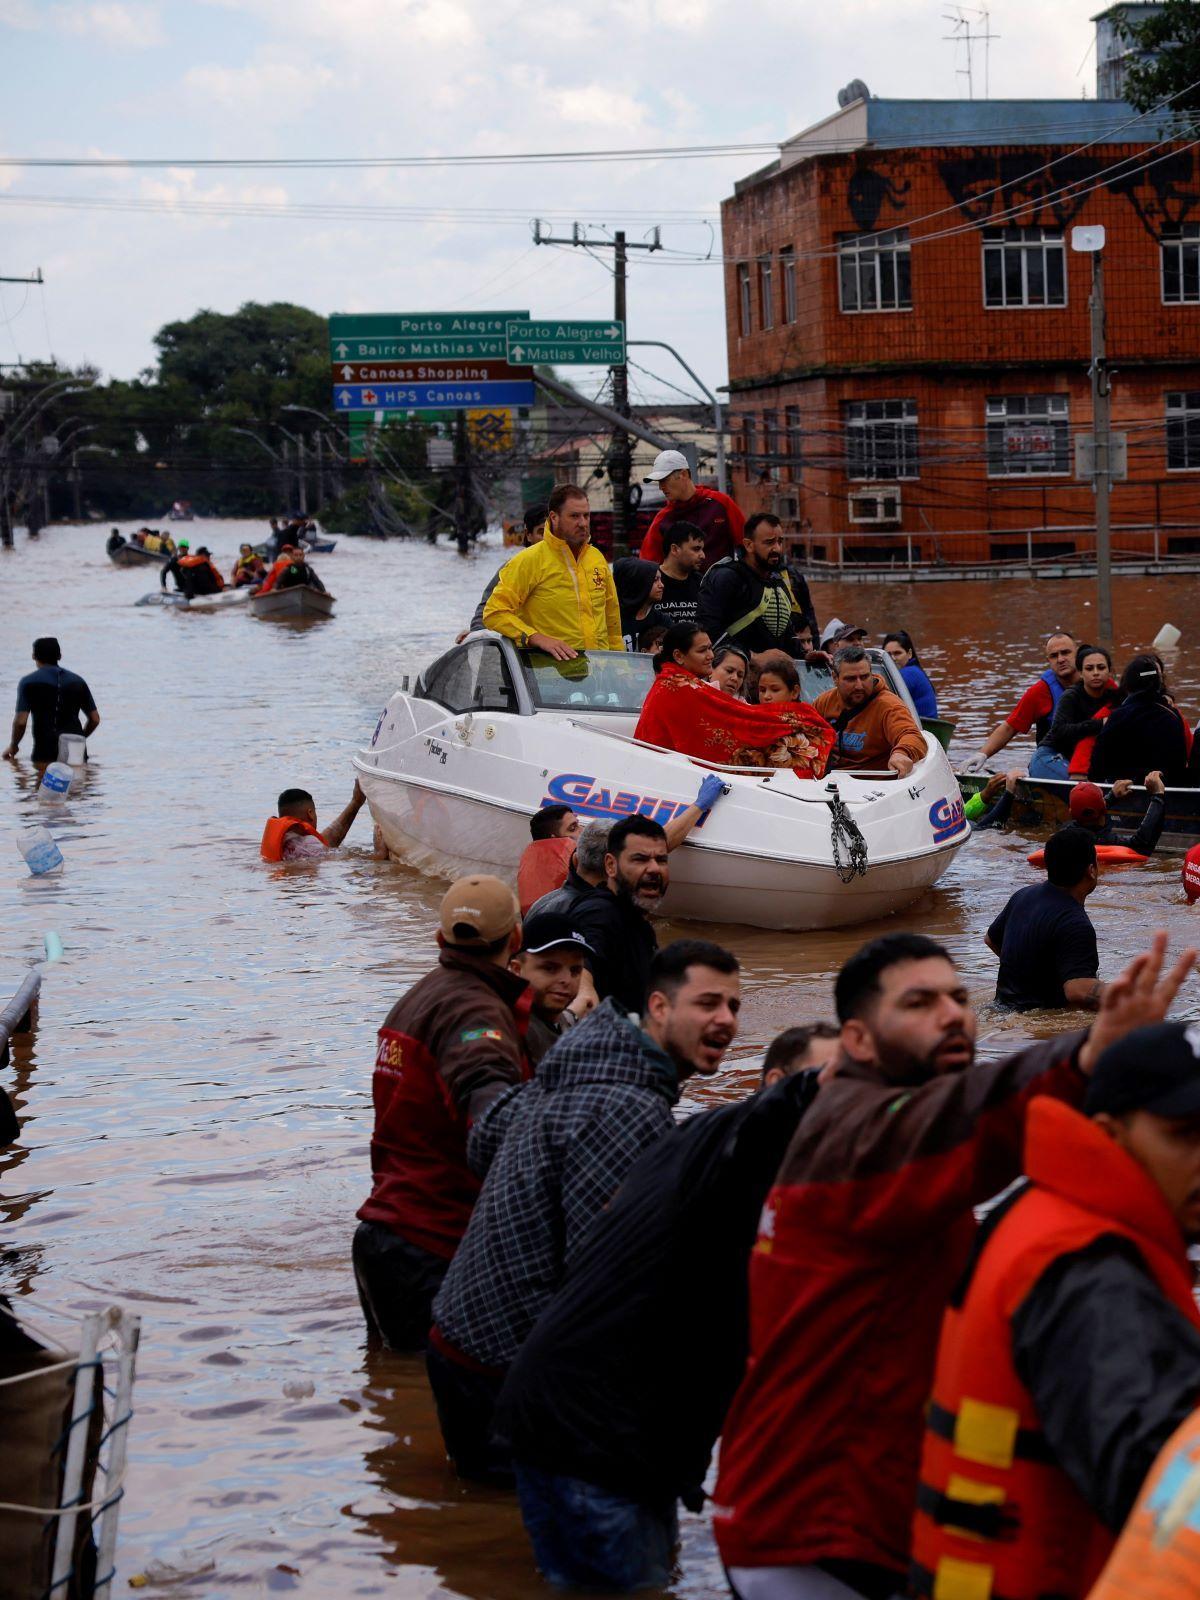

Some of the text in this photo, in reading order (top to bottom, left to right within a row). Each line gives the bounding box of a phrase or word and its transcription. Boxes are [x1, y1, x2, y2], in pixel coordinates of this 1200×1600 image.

[401, 319, 502, 333] Porto Alegre
[510, 326, 604, 341] Porto Alegre
[358, 341, 506, 356] Bairro Mathias Vel
[527, 347, 622, 360] Matias Velho
[359, 366, 489, 380] Canoas Shopping
[385, 389, 481, 402] HPS Canoas
[653, 600, 698, 610] QUALIDAD
